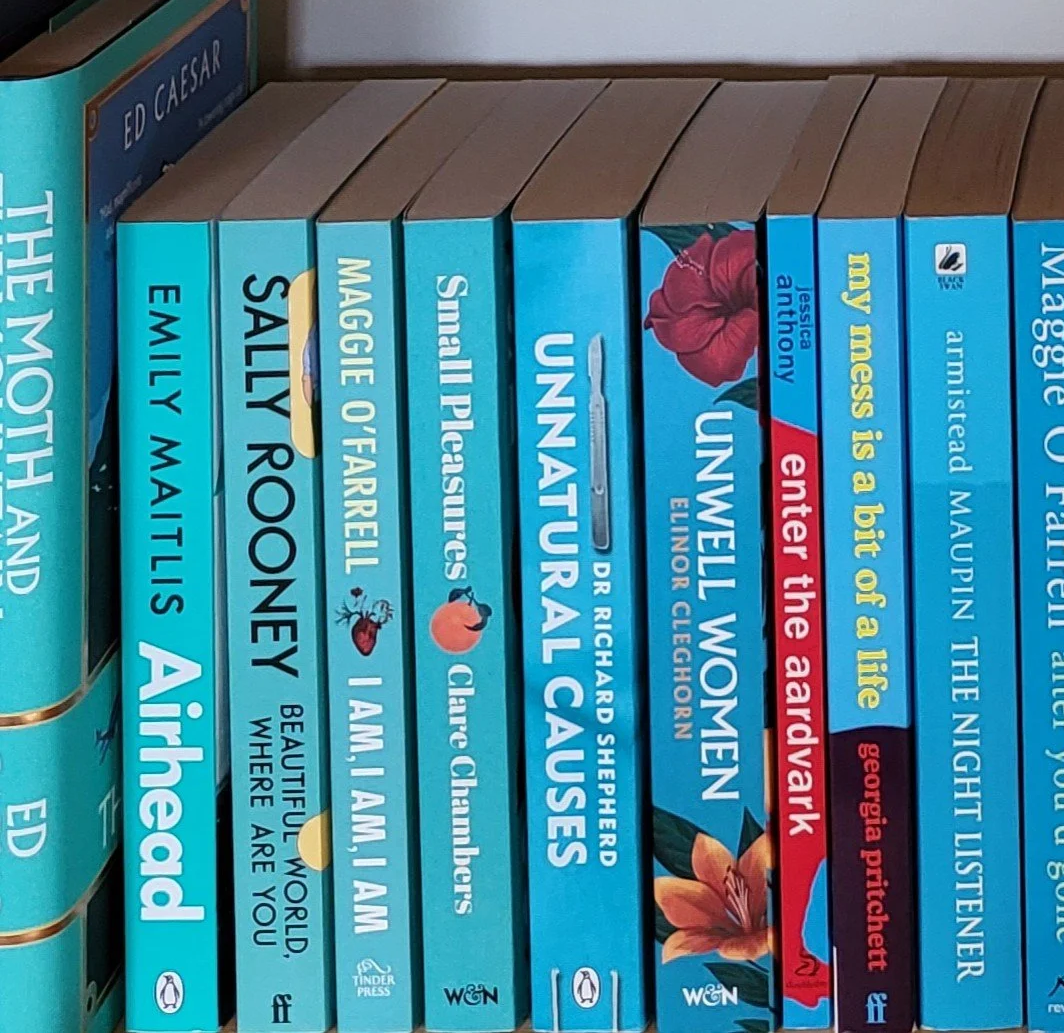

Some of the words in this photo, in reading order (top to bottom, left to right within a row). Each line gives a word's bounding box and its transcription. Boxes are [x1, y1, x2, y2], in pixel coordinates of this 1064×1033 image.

[149, 284, 182, 415] EMILY
[243, 273, 291, 420] SALLY
[337, 257, 374, 385] MAGGIE
[436, 274, 473, 398] Small
[775, 275, 795, 384] anthony
[796, 287, 812, 350] jessica
[946, 331, 972, 474] armistead
[149, 435, 184, 616] MAITLIS
[340, 401, 379, 575] O'FARRELL
[440, 404, 474, 580] Pleasures
[534, 333, 580, 664] UNNATURAL
[670, 497, 690, 590] ELINOR
[695, 410, 736, 600] UNWELL
[780, 453, 808, 561] enter
[247, 443, 299, 679] ROONEY
[592, 562, 610, 596] DR
[782, 577, 816, 638] the
[949, 489, 975, 619] MAUPIN
[447, 664, 474, 748] Clare
[594, 607, 613, 724] RICHARD
[672, 602, 692, 740] CLEGHORN
[697, 613, 739, 801] WOMEN
[951, 637, 978, 701] THE
[139, 641, 204, 922] Airhead
[250, 717, 274, 807] WHERE
[542, 678, 587, 868] CAUSES
[597, 734, 617, 867] SHEPHERD
[785, 656, 821, 835] aardvark
[858, 742, 882, 843] georgia
[952, 713, 980, 822] NIGHT
[251, 825, 275, 872] ARE
[449, 755, 479, 915] Chambers
[252, 885, 277, 947] YOU
[859, 850, 888, 971] pritchett
[954, 833, 984, 983] LISTENER
[352, 975, 395, 985] TINDER
[357, 986, 391, 997] PRESS
